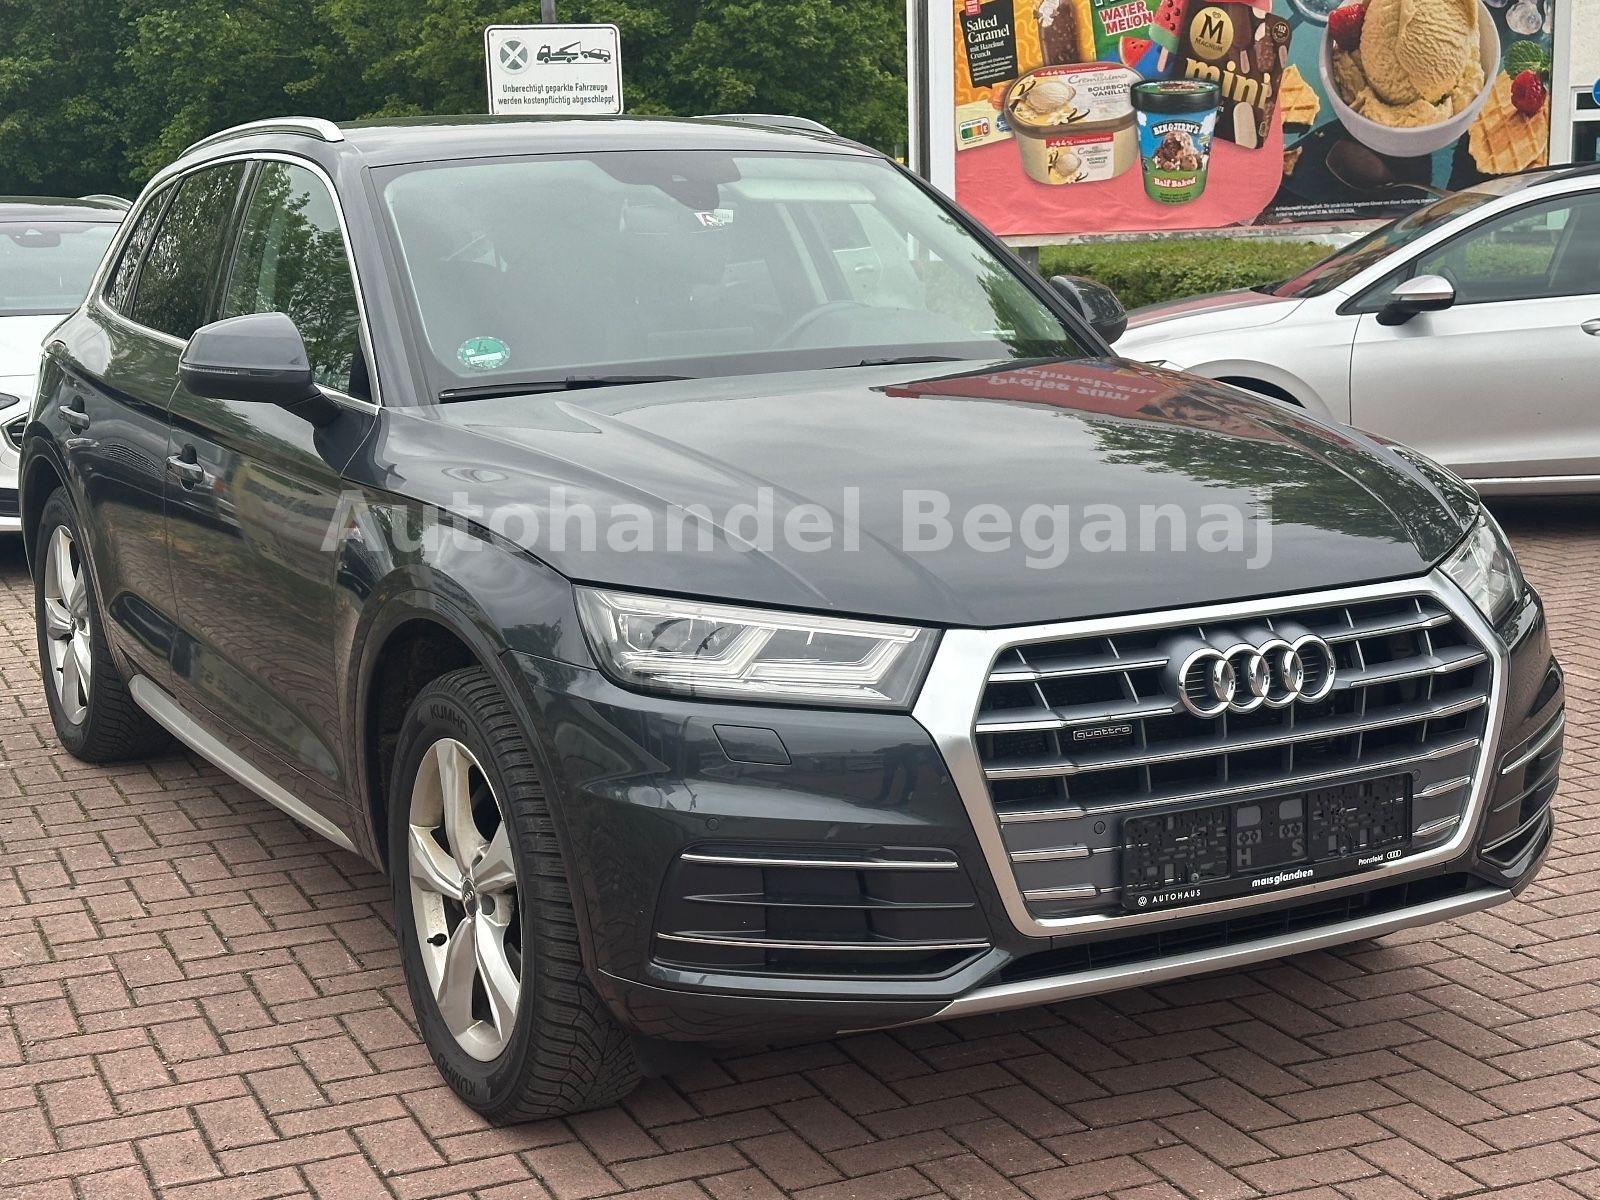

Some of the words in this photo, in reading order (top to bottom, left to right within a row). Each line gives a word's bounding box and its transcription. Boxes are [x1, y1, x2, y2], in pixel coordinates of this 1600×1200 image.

[1099, 1, 1146, 22] WATER
[966, 14, 998, 32] Salted
[1105, 11, 1153, 35] MELON
[967, 24, 1010, 43] Caramel
[1195, 38, 1223, 52] MAGNUM
[502, 84, 544, 94] Unberechtigt
[545, 84, 574, 94] geparkte
[575, 83, 608, 93] Fahrzeuge
[1087, 83, 1131, 93] BOURBON
[1184, 57, 1271, 109] mini
[1092, 88, 1128, 97] VANILLE
[498, 97, 522, 105] werden
[523, 95, 571, 106] kostenpflichtig
[572, 94, 615, 105] abgeschleppt
[1154, 177, 1171, 187] Half
[1171, 177, 1196, 188] Baked
[430, 704, 468, 736] KUMHO
[1077, 726, 1130, 739] quattro
[1152, 889, 1201, 904] AUTOHAUS
